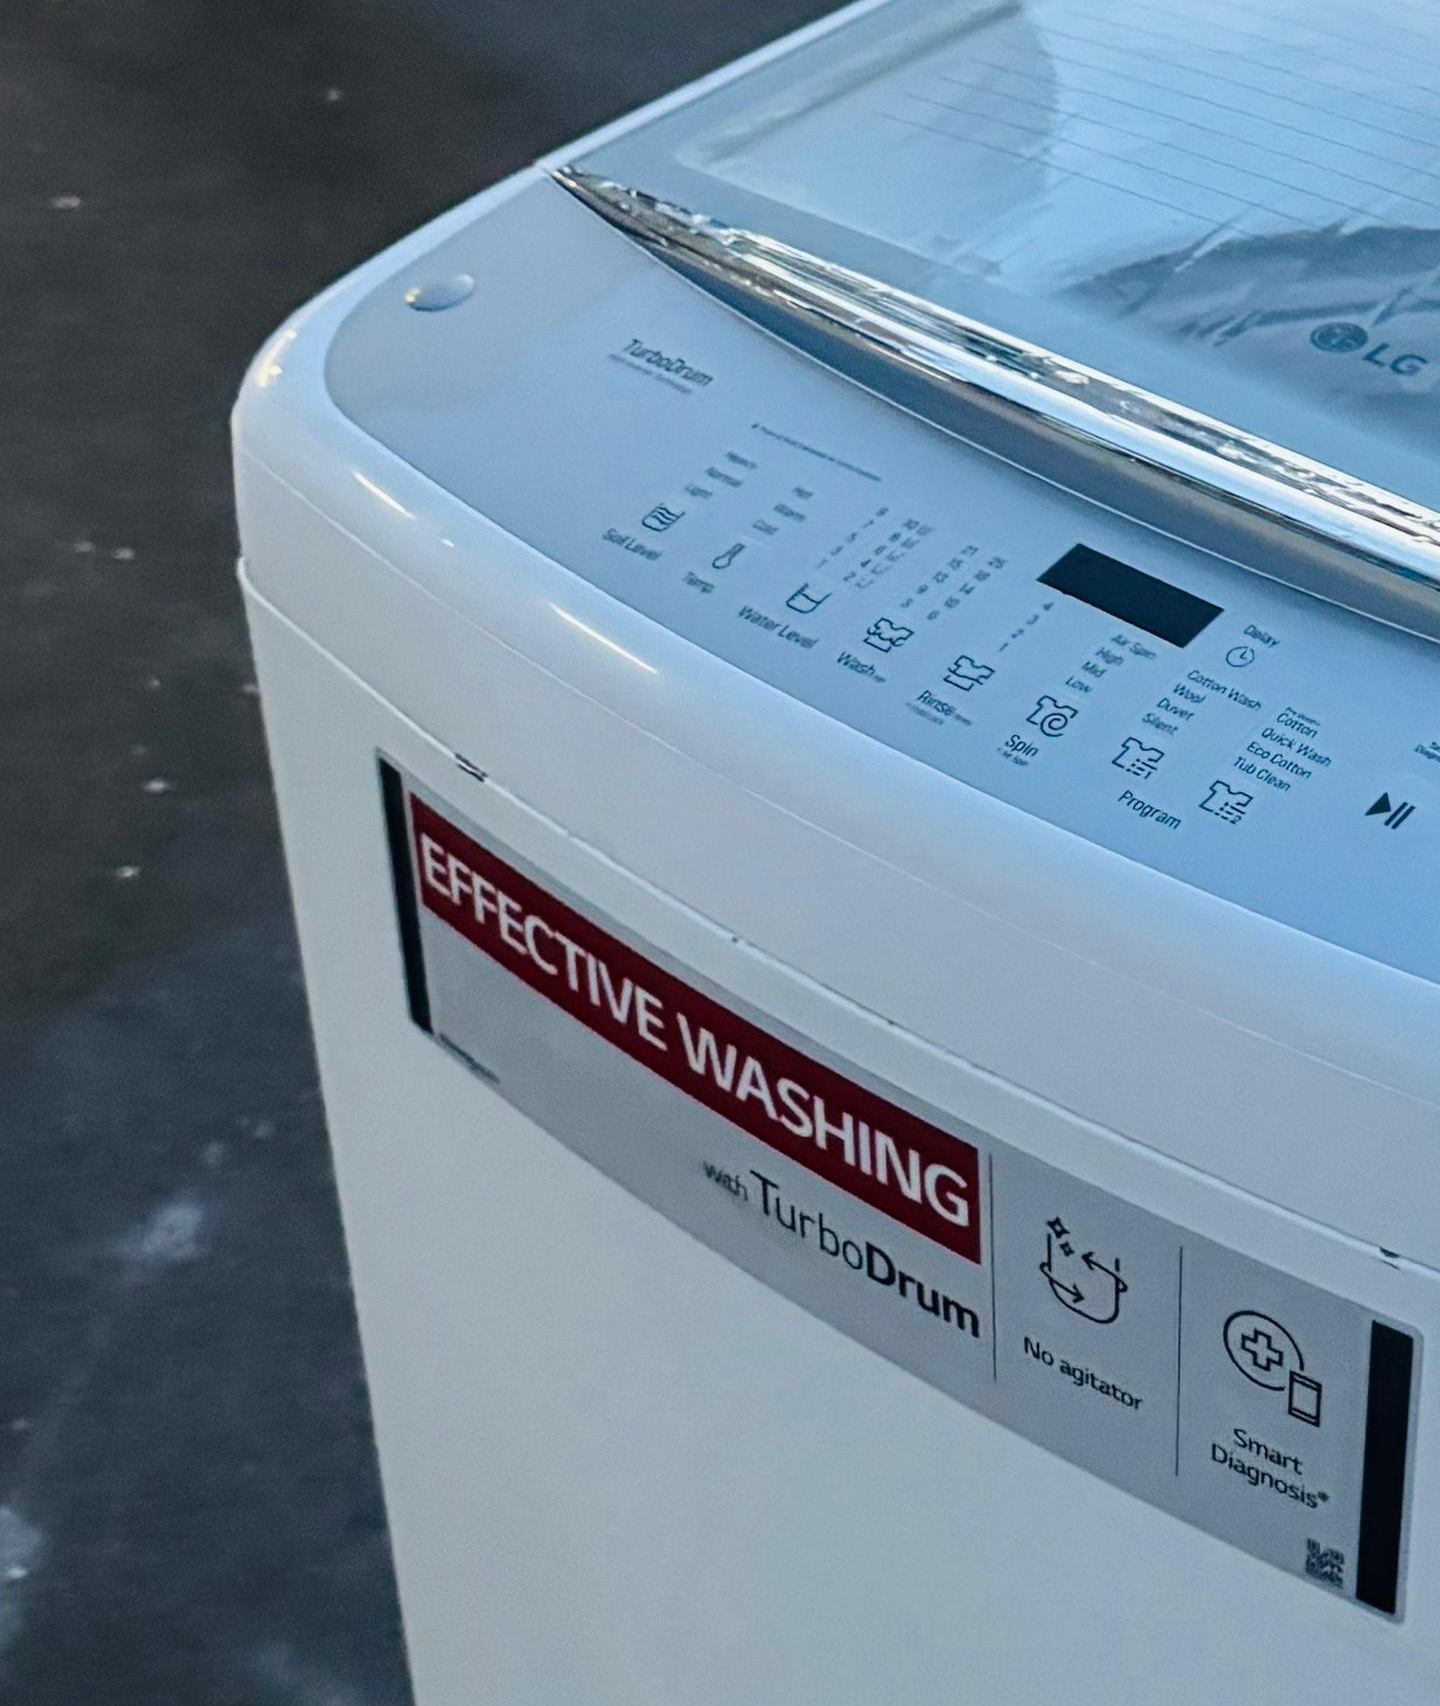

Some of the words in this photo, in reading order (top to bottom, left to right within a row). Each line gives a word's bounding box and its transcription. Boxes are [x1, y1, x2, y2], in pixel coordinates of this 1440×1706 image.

[624, 338, 714, 386] TurboDrum
[1362, 342, 1429, 377] LG
[738, 605, 782, 631] Water
[778, 625, 820, 649] Level
[836, 651, 876, 677] Wash
[1081, 661, 1107, 678] Mid
[1095, 647, 1125, 666] High
[1065, 676, 1093, 693] Low
[1172, 682, 1207, 704] Wool
[1187, 669, 1228, 695] Cotton
[1227, 687, 1262, 711] Wash
[916, 689, 956, 717] Rinse
[1156, 697, 1195, 722] Duvet
[1141, 712, 1178, 736] Silent
[1276, 712, 1318, 739] Cotton
[1003, 734, 1039, 757] Spin
[1246, 741, 1270, 760] Eco
[1270, 753, 1312, 779] Cotton
[1261, 726, 1297, 749] Quick
[1295, 745, 1333, 768] Wash
[1232, 756, 1257, 774] Tub
[1256, 768, 1291, 792] Clean
[1117, 790, 1182, 830] Program
[420, 832, 668, 1052] EFFECTIVE
[677, 1012, 970, 1227] WASHING
[702, 1160, 749, 1203] with
[749, 1169, 981, 1339] TurboDrum
[1023, 1336, 1055, 1368] No
[1059, 1359, 1144, 1411] agitator
[1233, 1428, 1303, 1476] Smart
